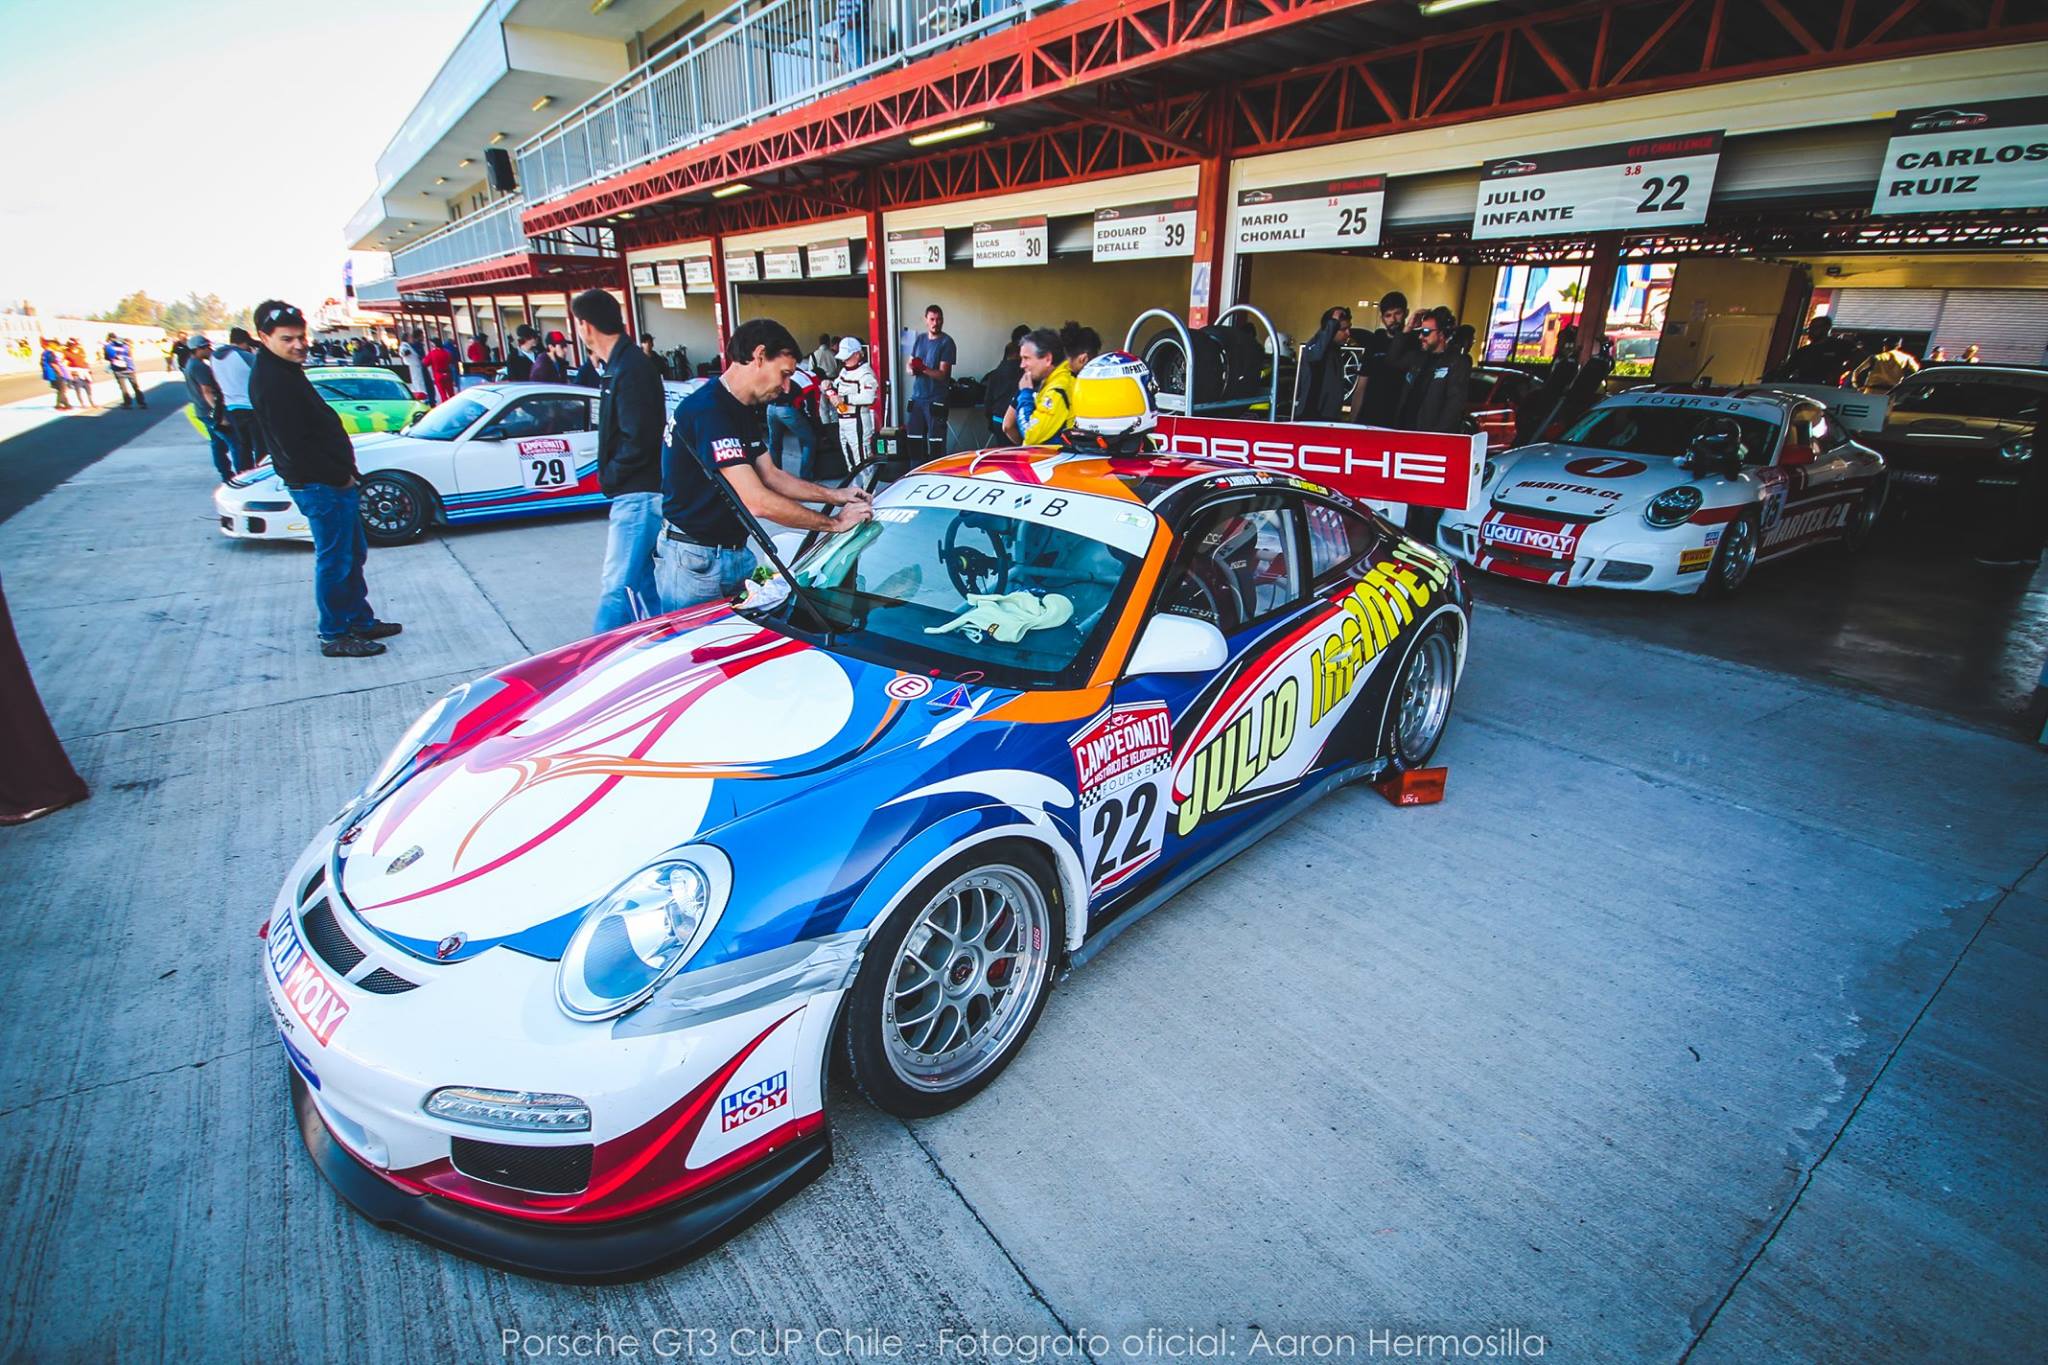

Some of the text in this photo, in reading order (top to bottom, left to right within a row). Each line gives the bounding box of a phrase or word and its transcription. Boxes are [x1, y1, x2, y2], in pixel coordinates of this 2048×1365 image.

[1896, 143, 2048, 170] CARLOS
[1624, 165, 1642, 176] 3.8
[1484, 175, 1690, 213] JULIO 22
[1889, 175, 1980, 197] RUIZ
[1241, 207, 1368, 236] MARIO 25
[1481, 206, 1575, 226] INFANTE
[1097, 223, 1185, 247] EDOUARD 39
[1097, 241, 1140, 252] DETALLE
[1241, 228, 1305, 242] CHOMALI
[928, 246, 940, 263] 29
[976, 238, 1041, 257] LUCAS 30
[976, 250, 1016, 260] MACHICAO
[838, 254, 847, 269] 23
[1635, 396, 1741, 412] FOUR B
[712, 438, 741, 451] LIQUI
[714, 447, 744, 462] MOLY
[532, 458, 565, 486] 29
[905, 484, 1069, 517] FOUR B
[1515, 480, 1623, 500] MARITEX.CL
[1484, 523, 1573, 552] LIQUI MOLY
[897, 681, 921, 694] E
[1076, 711, 1170, 784] CAMPEONATO
[1178, 675, 1299, 836] JULIO
[1102, 764, 1151, 794] FOUR B
[1091, 782, 1158, 886] 22
[269, 911, 303, 981] LIQUI
[285, 955, 348, 1038] MOLY
[724, 1073, 785, 1114] LIQUI
[725, 1089, 786, 1131] MOLY
